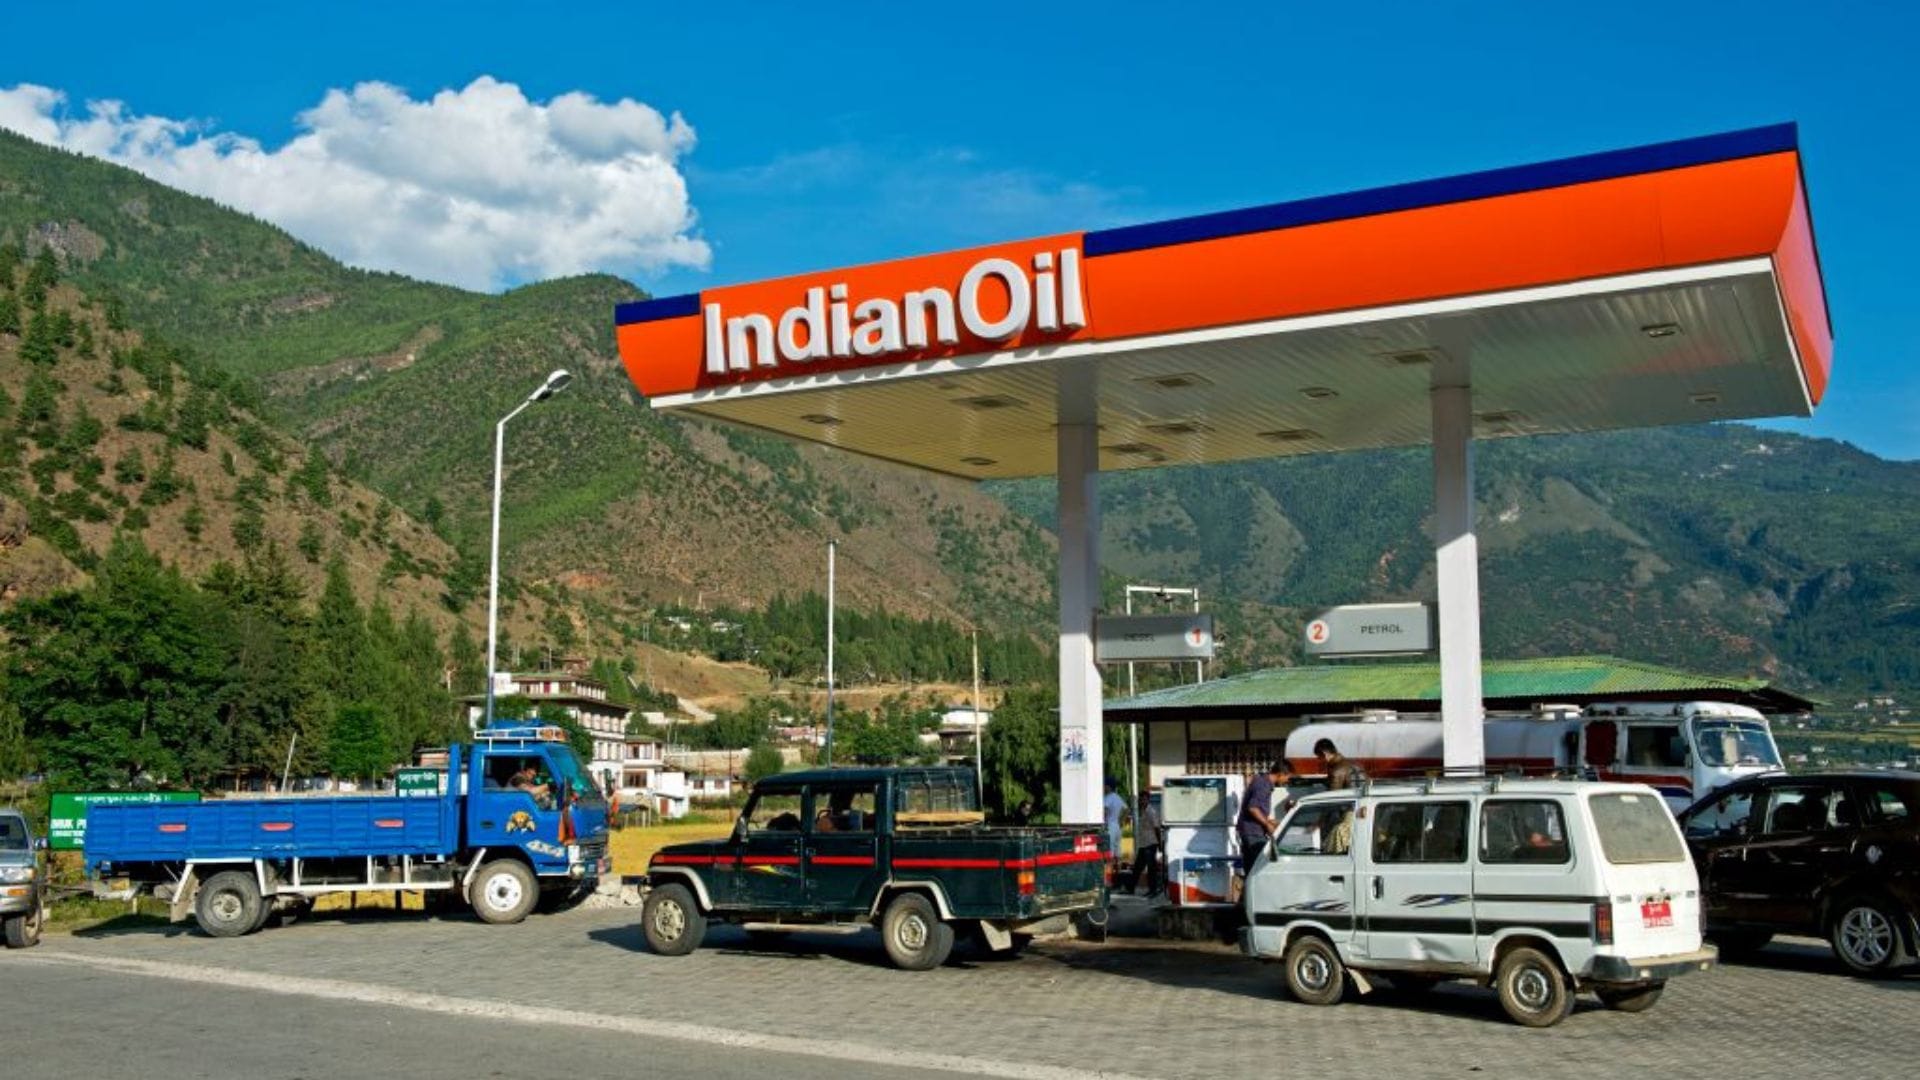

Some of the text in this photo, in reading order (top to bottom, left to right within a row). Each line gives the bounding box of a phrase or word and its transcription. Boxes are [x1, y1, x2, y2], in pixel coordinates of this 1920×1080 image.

[704, 248, 1087, 374] IndianOil
[1191, 627, 1201, 644] 1
[1313, 623, 1404, 640] 2 PETROL
